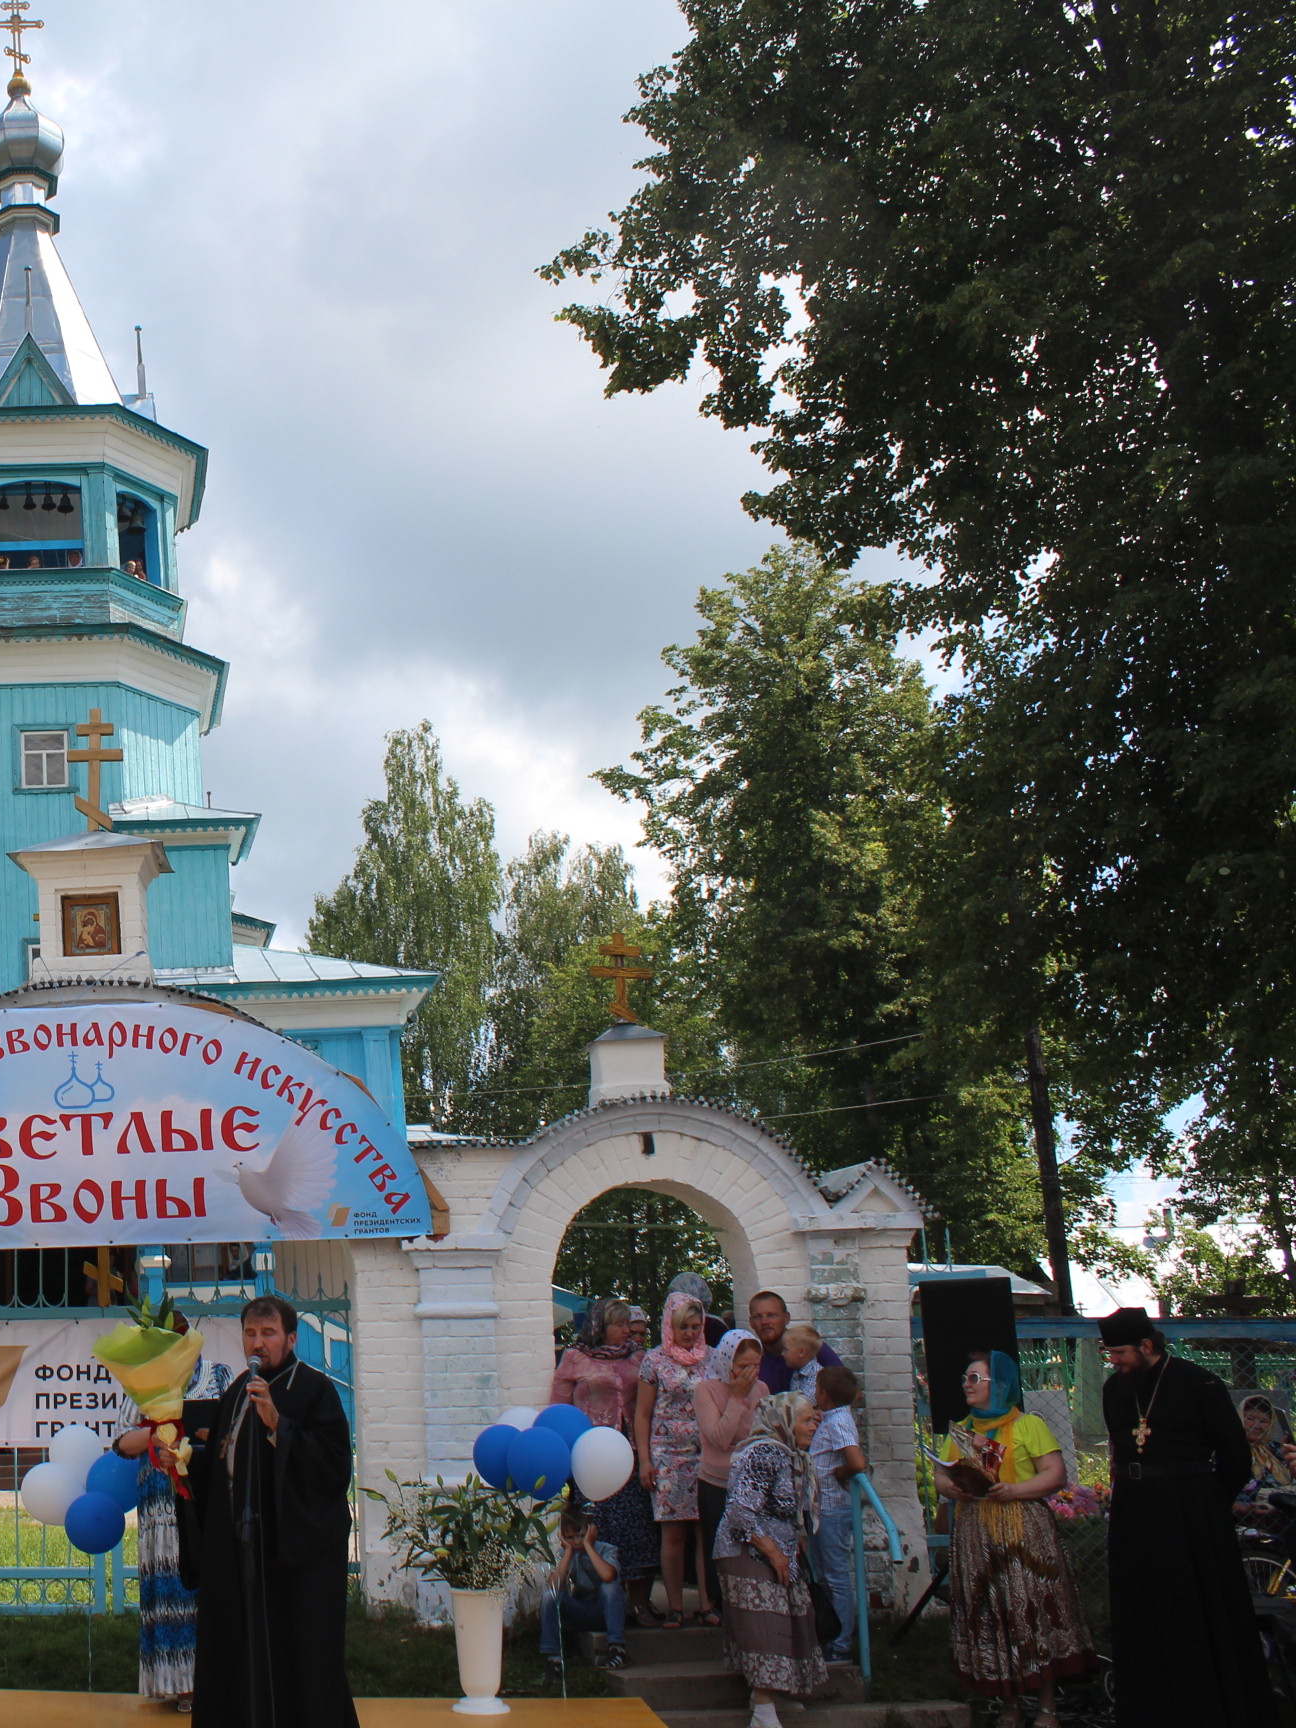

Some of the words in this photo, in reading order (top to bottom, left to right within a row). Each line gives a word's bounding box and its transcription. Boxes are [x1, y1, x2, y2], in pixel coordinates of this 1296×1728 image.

[353, 1211, 378, 1219] ФОНД
[353, 1218, 422, 1226] ПРЕЗИДЕНТСКИХ
[354, 1227, 390, 1235] ГРАНТОВ
[34, 1363, 112, 1384] ФОНД
[35, 1392, 126, 1410] ПРЕЗИ
